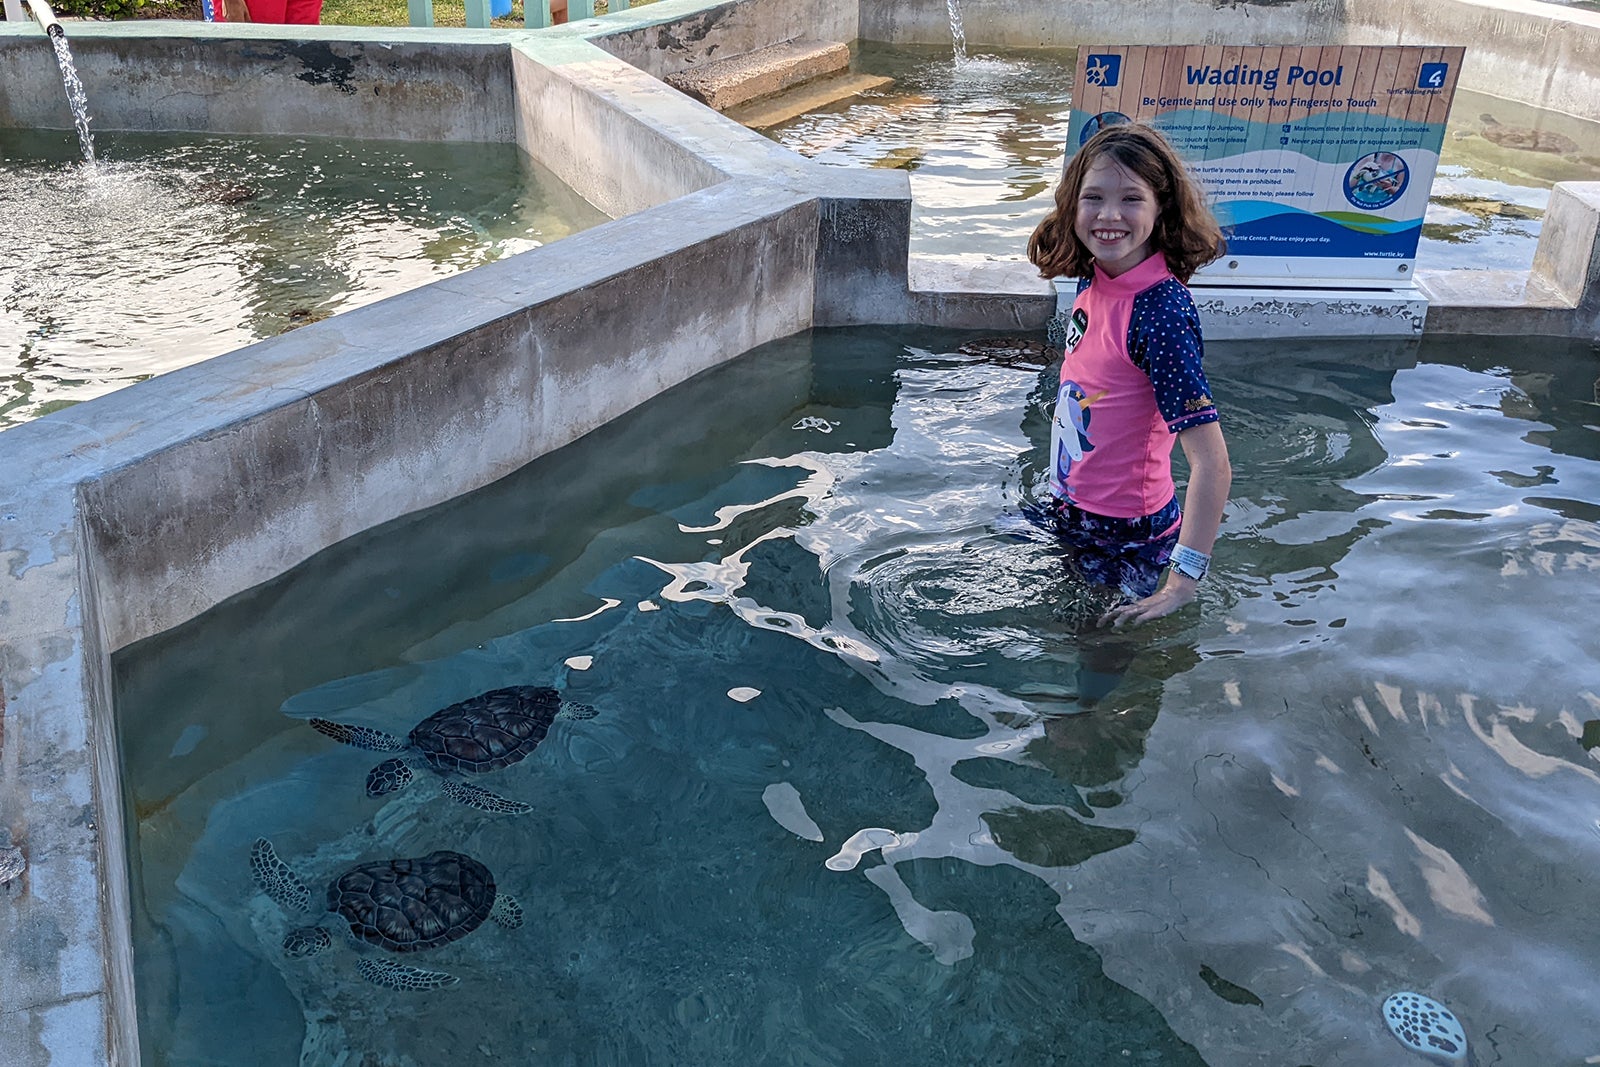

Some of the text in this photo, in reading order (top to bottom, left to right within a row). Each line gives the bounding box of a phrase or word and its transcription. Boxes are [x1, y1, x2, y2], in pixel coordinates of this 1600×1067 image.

[1186, 64, 1343, 91] Wading Pool
[1428, 70, 1442, 87] 4
[1142, 97, 1377, 109] Be Gentle and Use Only Two Fingers to Touch
[1162, 124, 1192, 132] splashing
[1375, 126, 1391, 134] pool
[1367, 139, 1394, 147] squeeze
